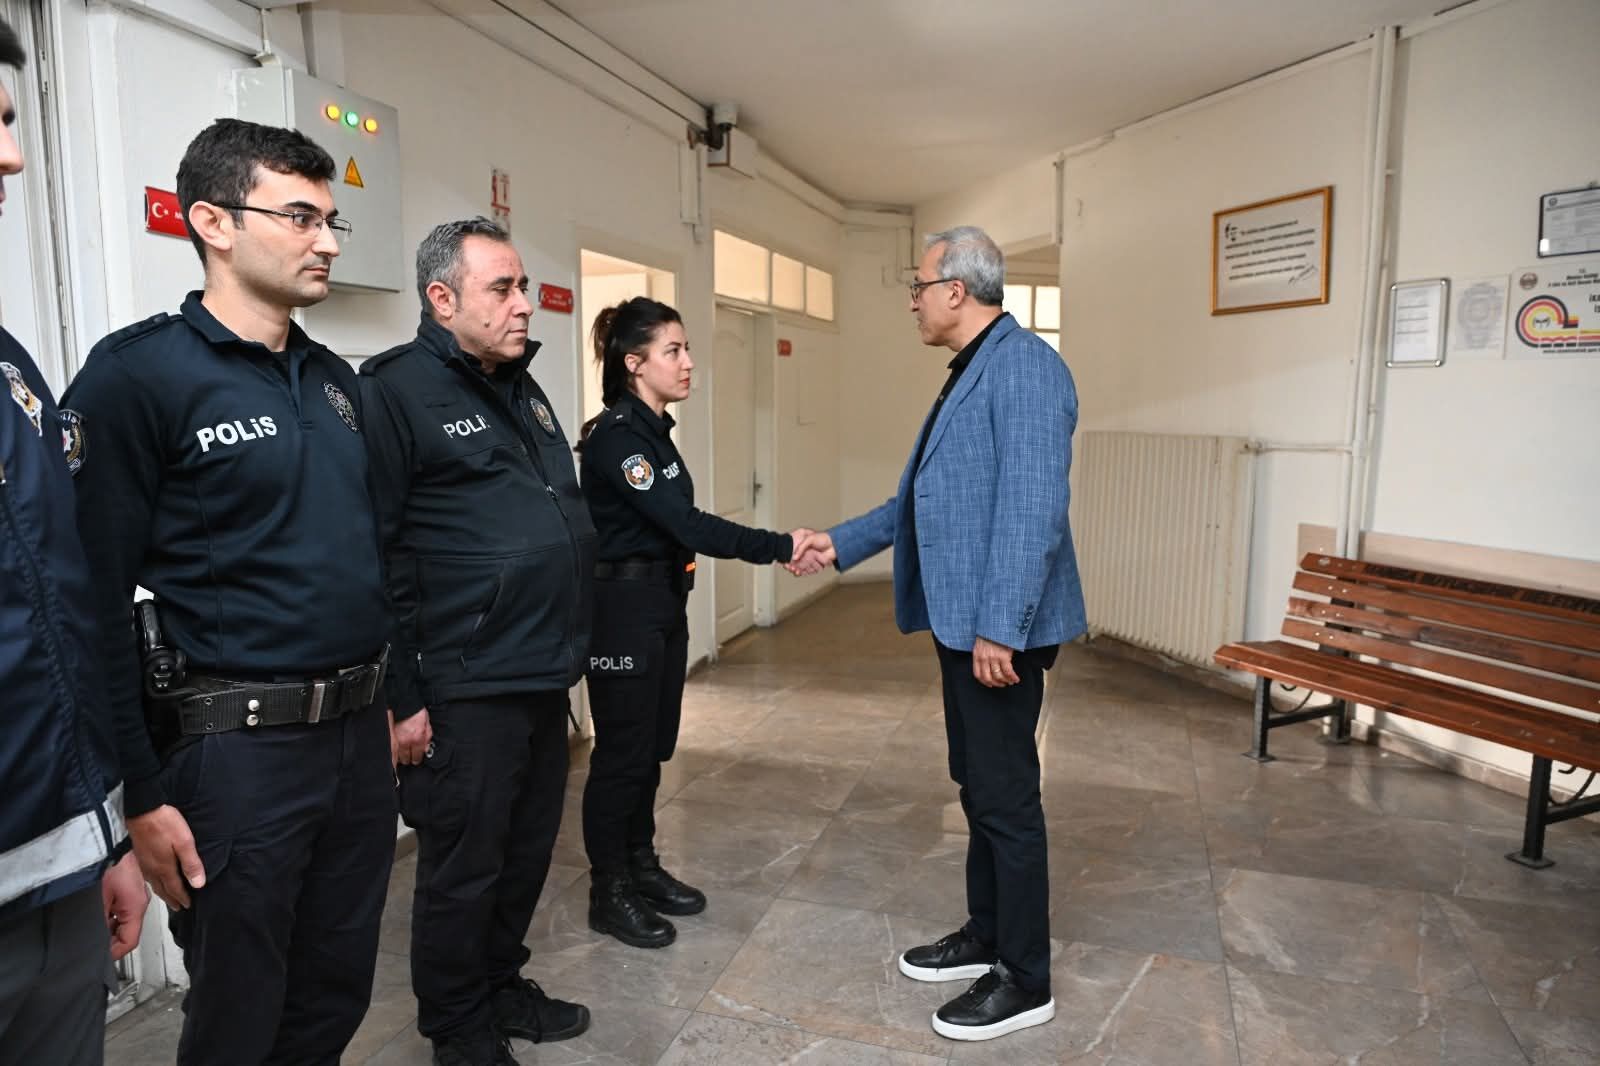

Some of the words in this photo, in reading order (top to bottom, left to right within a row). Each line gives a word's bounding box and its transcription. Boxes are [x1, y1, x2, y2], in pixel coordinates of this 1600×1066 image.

[196, 415, 278, 453] POLİS
[442, 414, 488, 439] POLİ
[590, 656, 634, 670] POLİS
